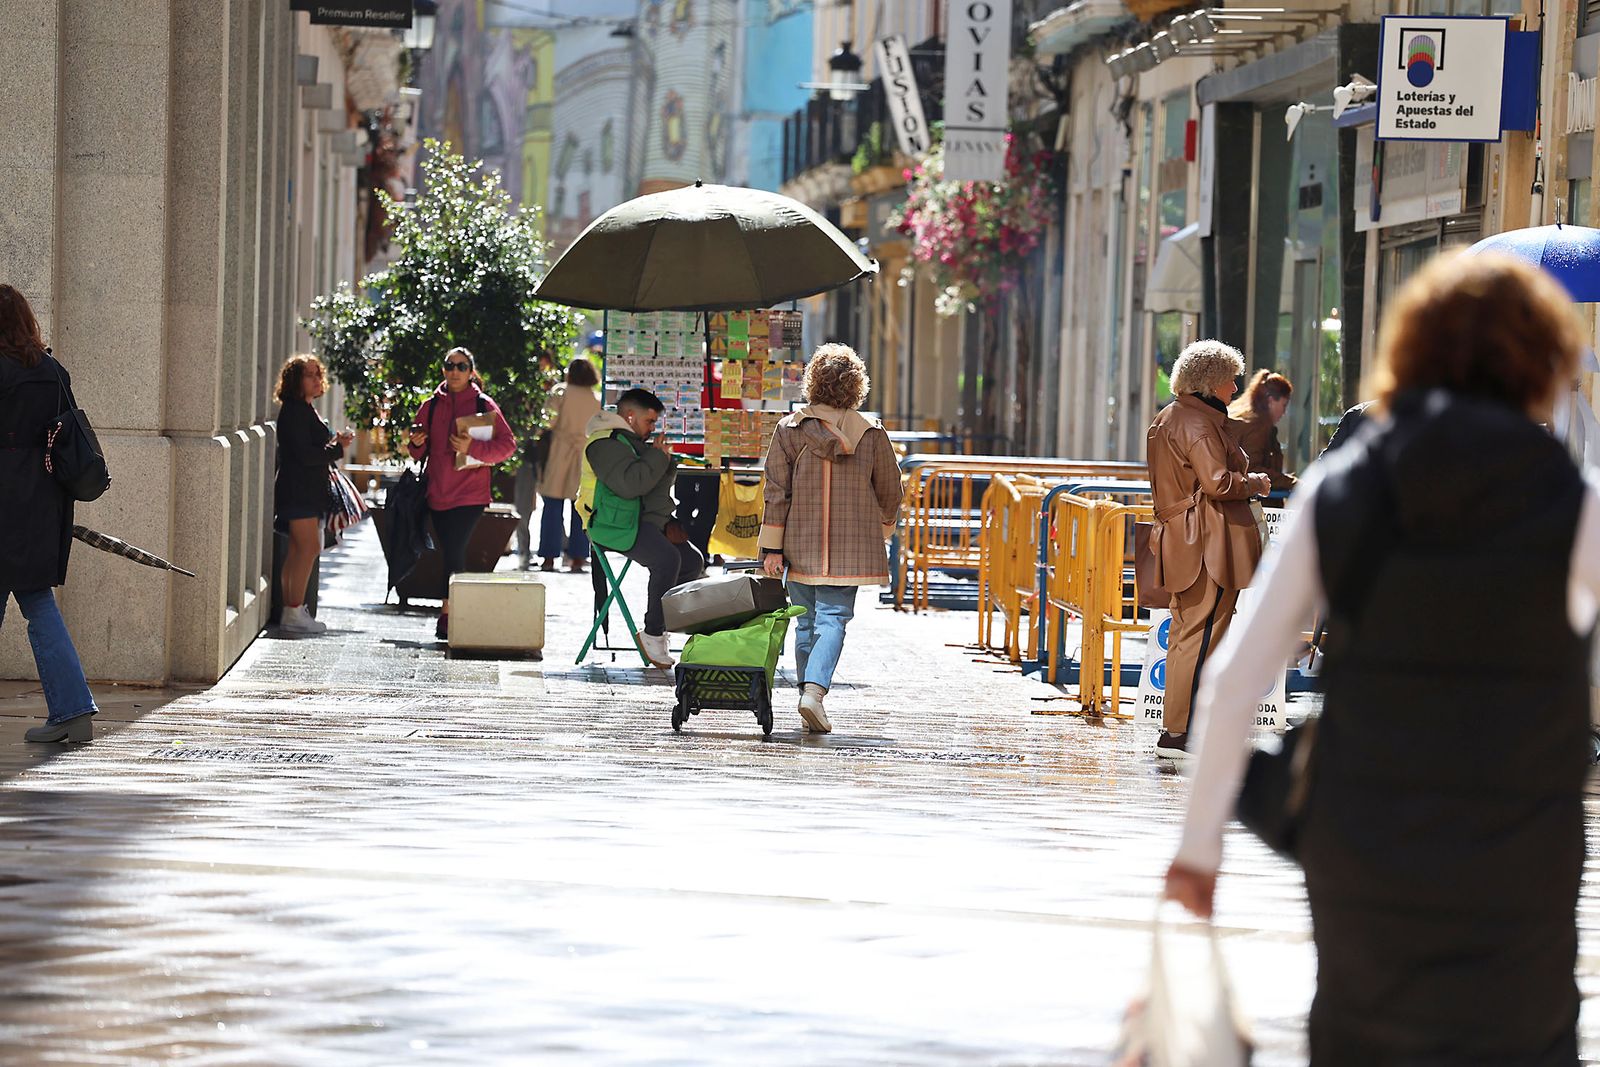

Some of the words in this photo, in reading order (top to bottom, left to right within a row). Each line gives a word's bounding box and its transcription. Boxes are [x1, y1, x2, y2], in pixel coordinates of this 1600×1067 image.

[317, 7, 363, 19] Premium
[365, 9, 405, 21] Reseller
[965, 2, 992, 123] OVIAS
[880, 36, 923, 155] FUSION
[1397, 90, 1445, 102] Loterías
[1448, 94, 1456, 105] y
[1396, 104, 1452, 117] Apuestas
[1455, 105, 1474, 116] del
[1395, 118, 1437, 129] Estado
[1256, 703, 1278, 713] ODA
